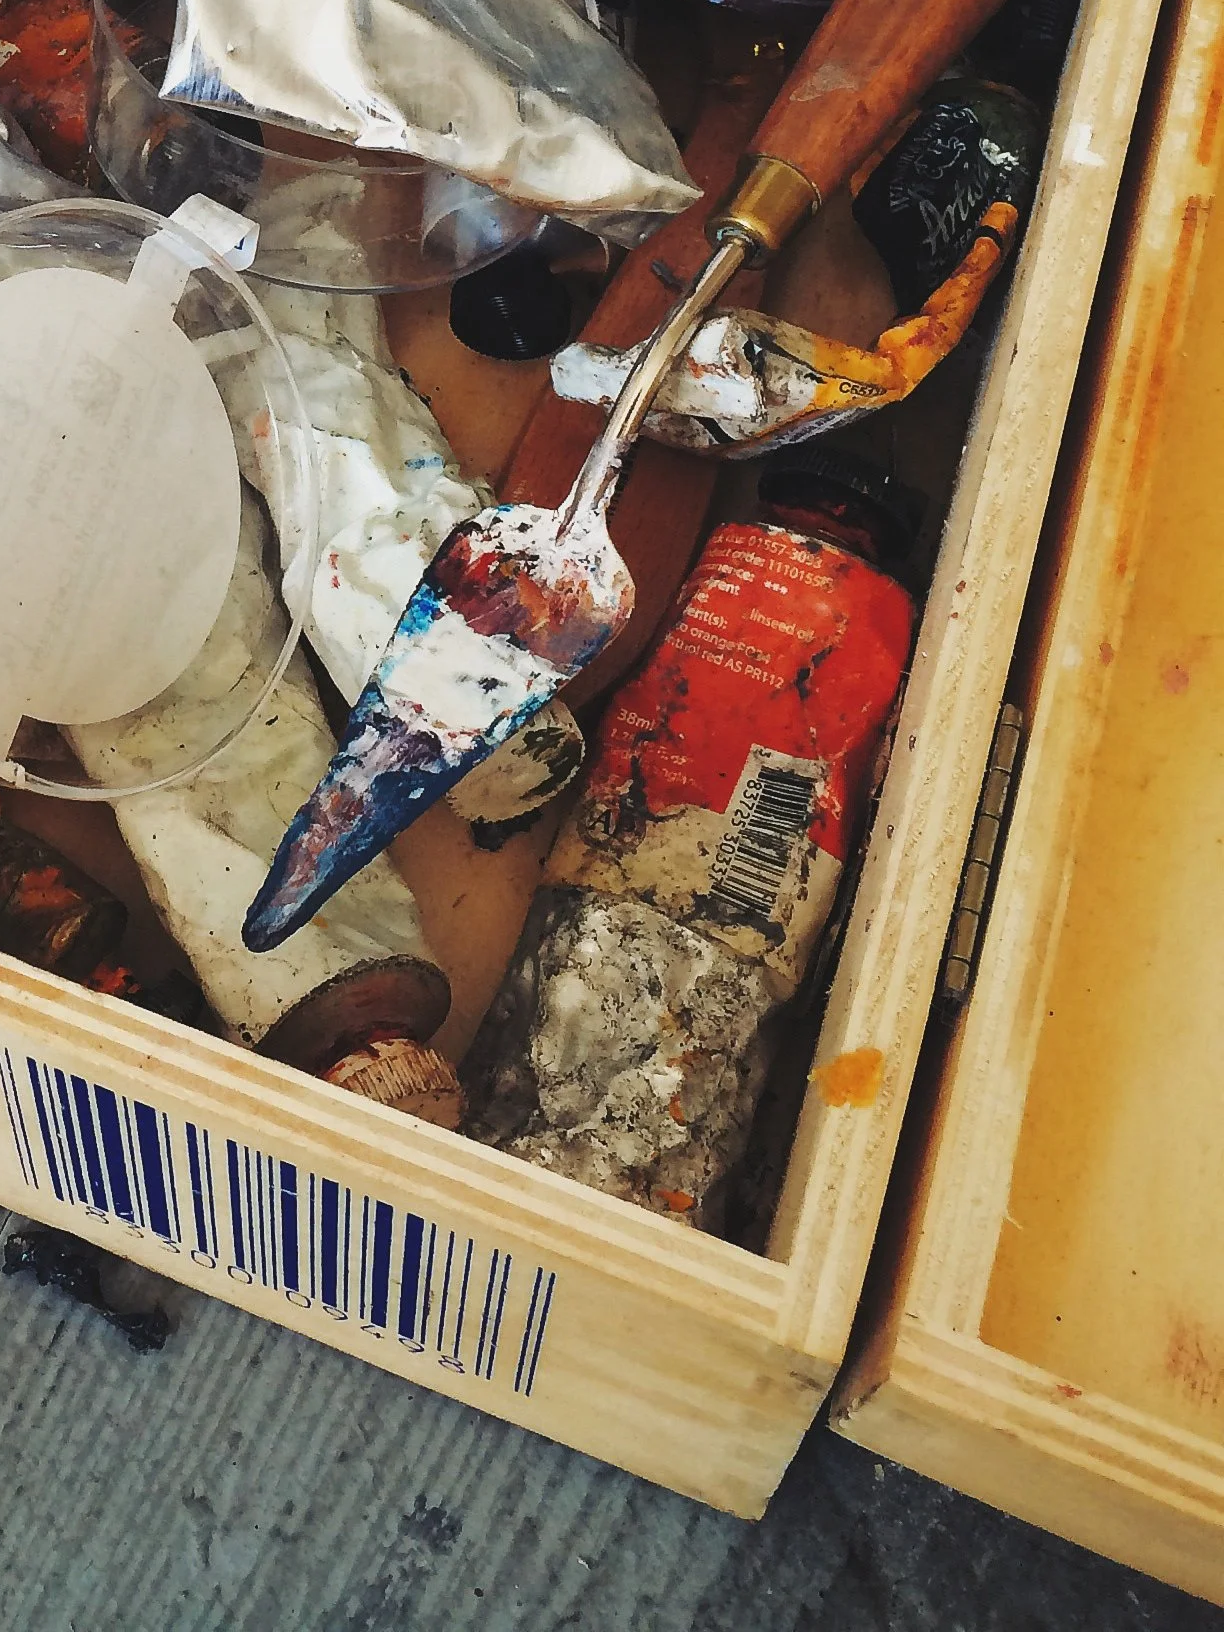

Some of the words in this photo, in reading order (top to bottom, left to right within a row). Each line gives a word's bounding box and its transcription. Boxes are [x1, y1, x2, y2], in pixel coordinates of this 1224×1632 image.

[749, 608, 795, 636] linseed
[690, 627, 733, 651] orange
[701, 649, 723, 666] red
[724, 658, 743, 673] AS
[744, 664, 785, 689] PR112
[616, 708, 656, 731] 38ml
[731, 778, 764, 830] 83725
